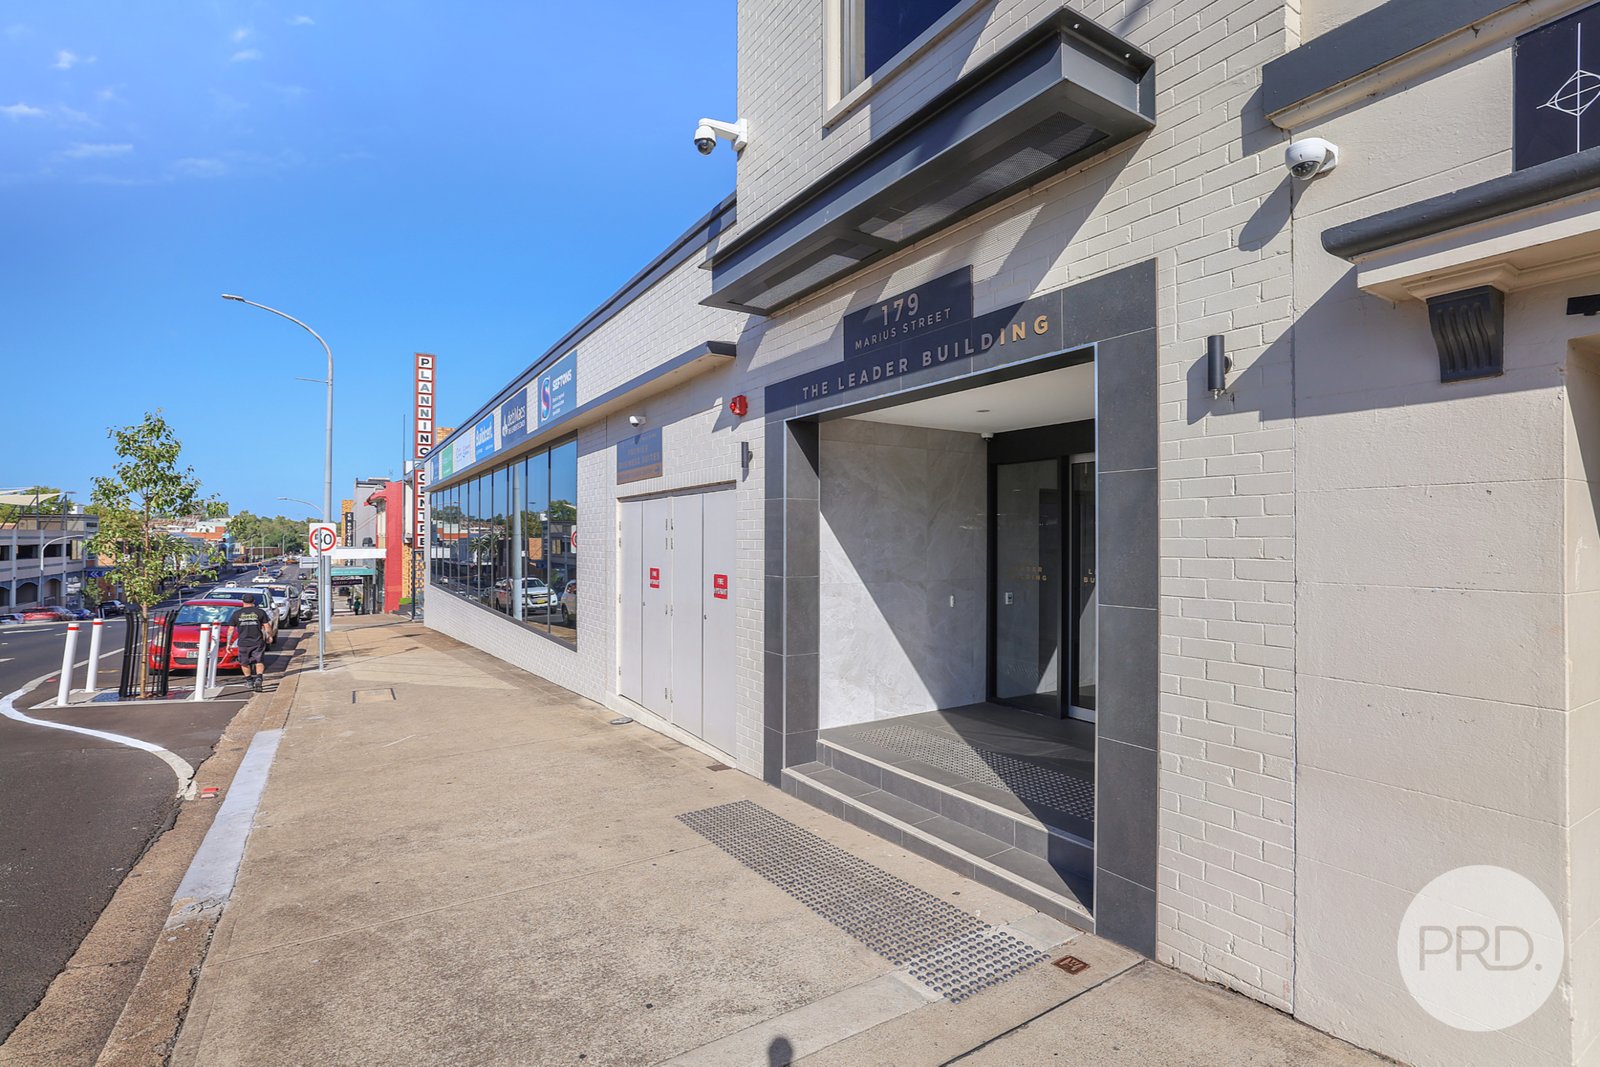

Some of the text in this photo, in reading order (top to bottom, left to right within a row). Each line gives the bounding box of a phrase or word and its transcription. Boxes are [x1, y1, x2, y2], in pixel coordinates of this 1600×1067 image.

[855, 308, 951, 350] MARIUS STREET
[882, 293, 919, 326] 179
[802, 315, 1049, 400] THE LEADER BUILDING
